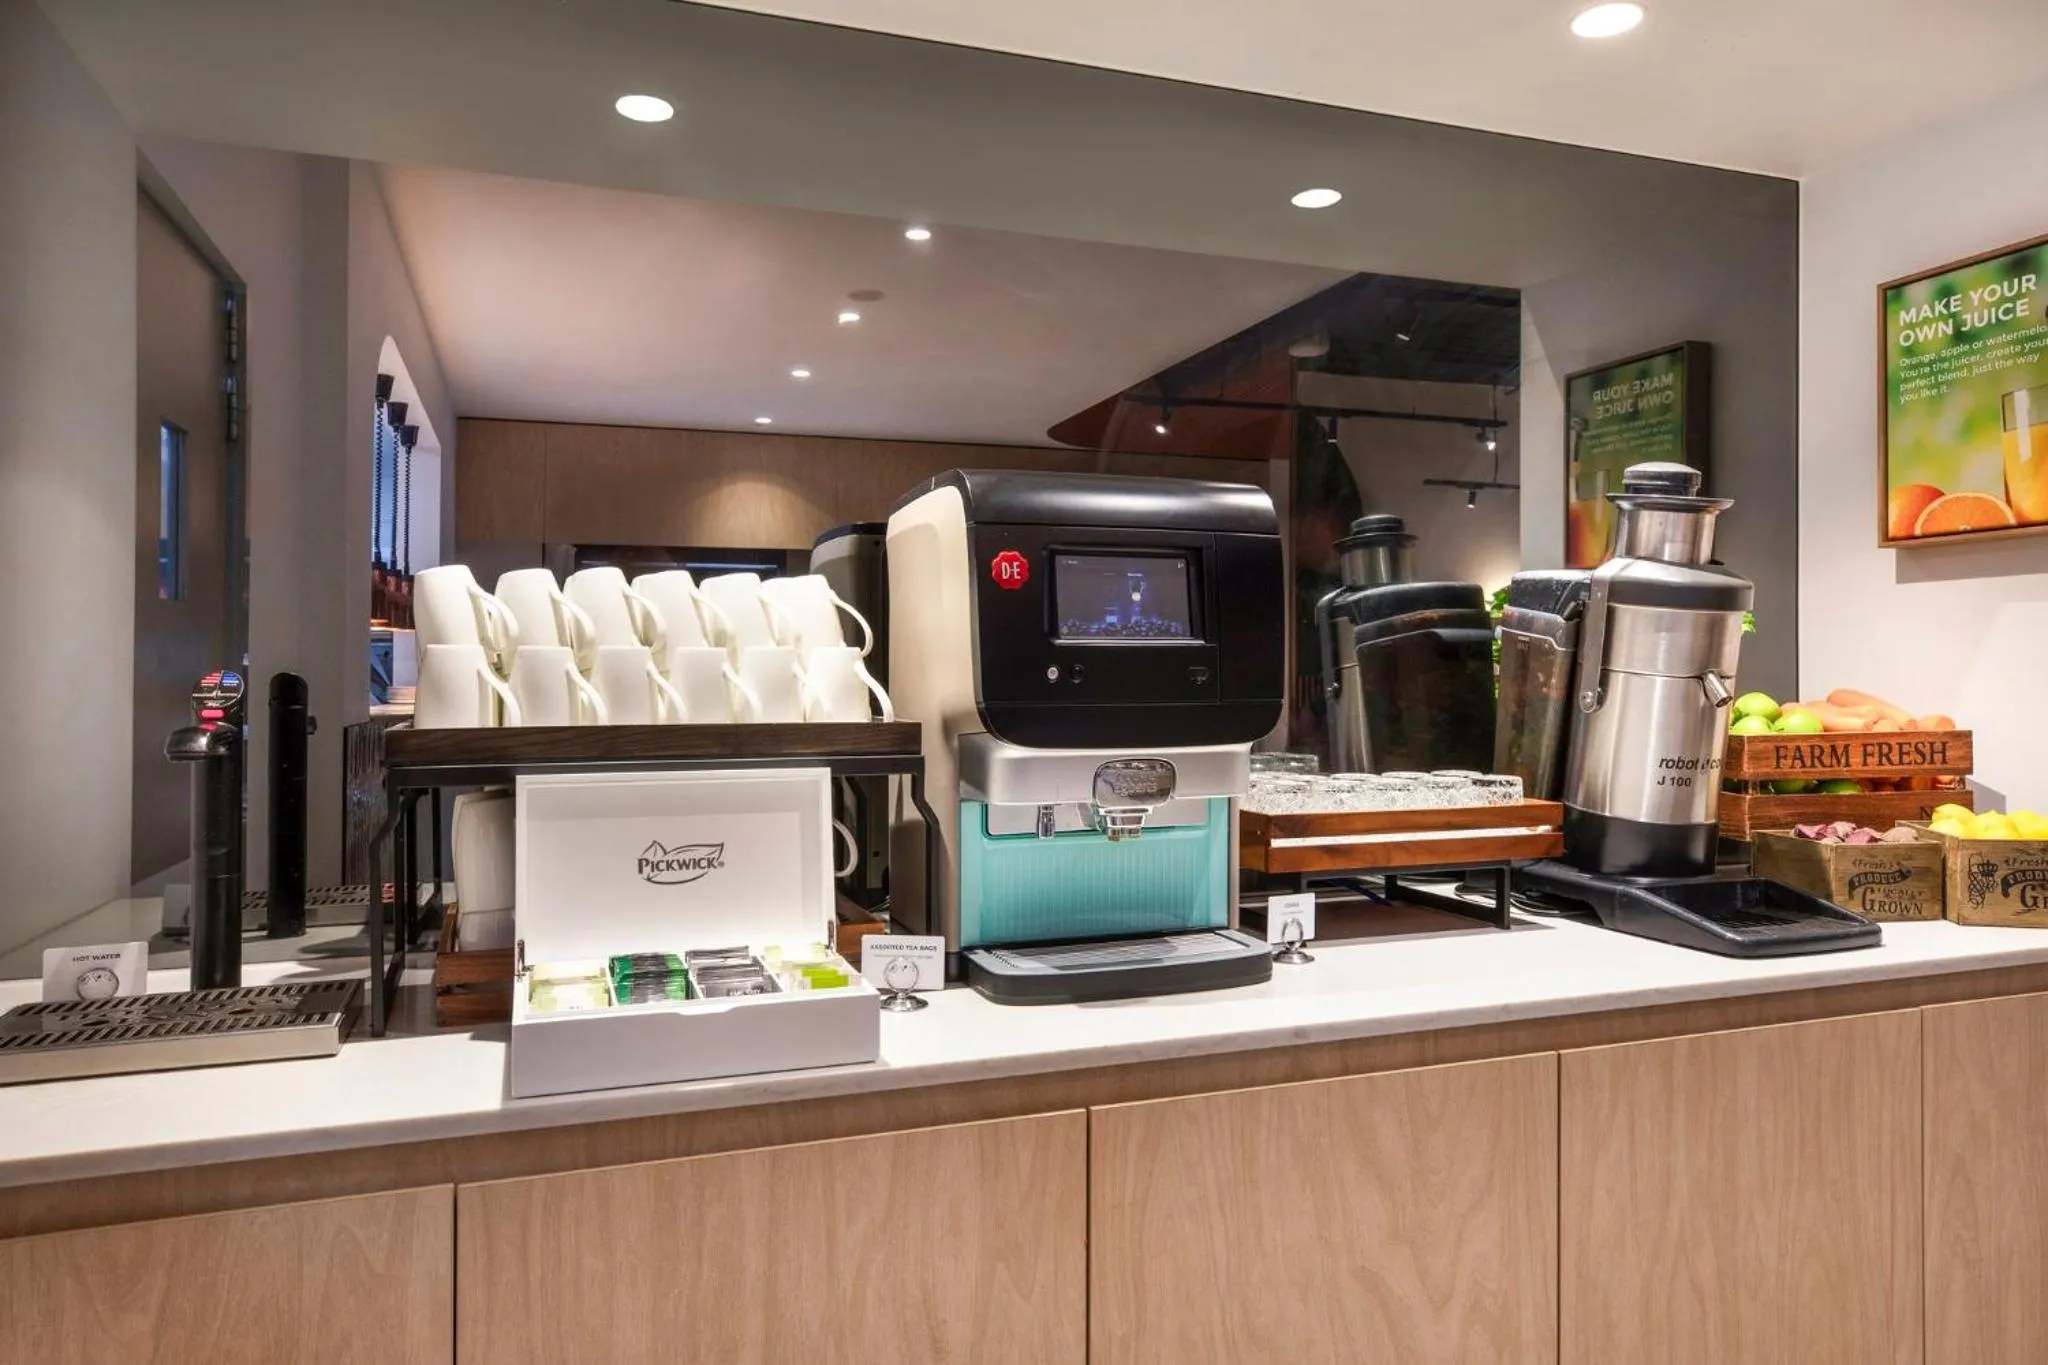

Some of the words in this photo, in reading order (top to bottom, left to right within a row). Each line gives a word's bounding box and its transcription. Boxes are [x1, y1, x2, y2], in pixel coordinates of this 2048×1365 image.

[1900, 294, 1962, 326] MAKE
[1969, 274, 2037, 306] YOUR
[1899, 318, 1953, 347] OWN
[1961, 298, 2030, 331] JUICE
[1941, 343, 1970, 358] apple
[1972, 341, 1983, 349] or
[1986, 324, 2048, 346] watermelo
[1900, 376, 1935, 392] perfect
[1972, 362, 1993, 377] just
[1995, 357, 2013, 370] the
[2016, 352, 2040, 365] way
[1933, 360, 1950, 372] the
[1986, 345, 2021, 359] create
[1900, 391, 1918, 405] you
[1920, 385, 1938, 398] like
[1774, 743, 1850, 769] FARM
[1860, 741, 1949, 767] FRESH
[1657, 776, 1666, 786] J
[1670, 776, 1692, 787] 100
[637, 857, 717, 874] PICKWICK
[1862, 887, 1924, 915] GROWN
